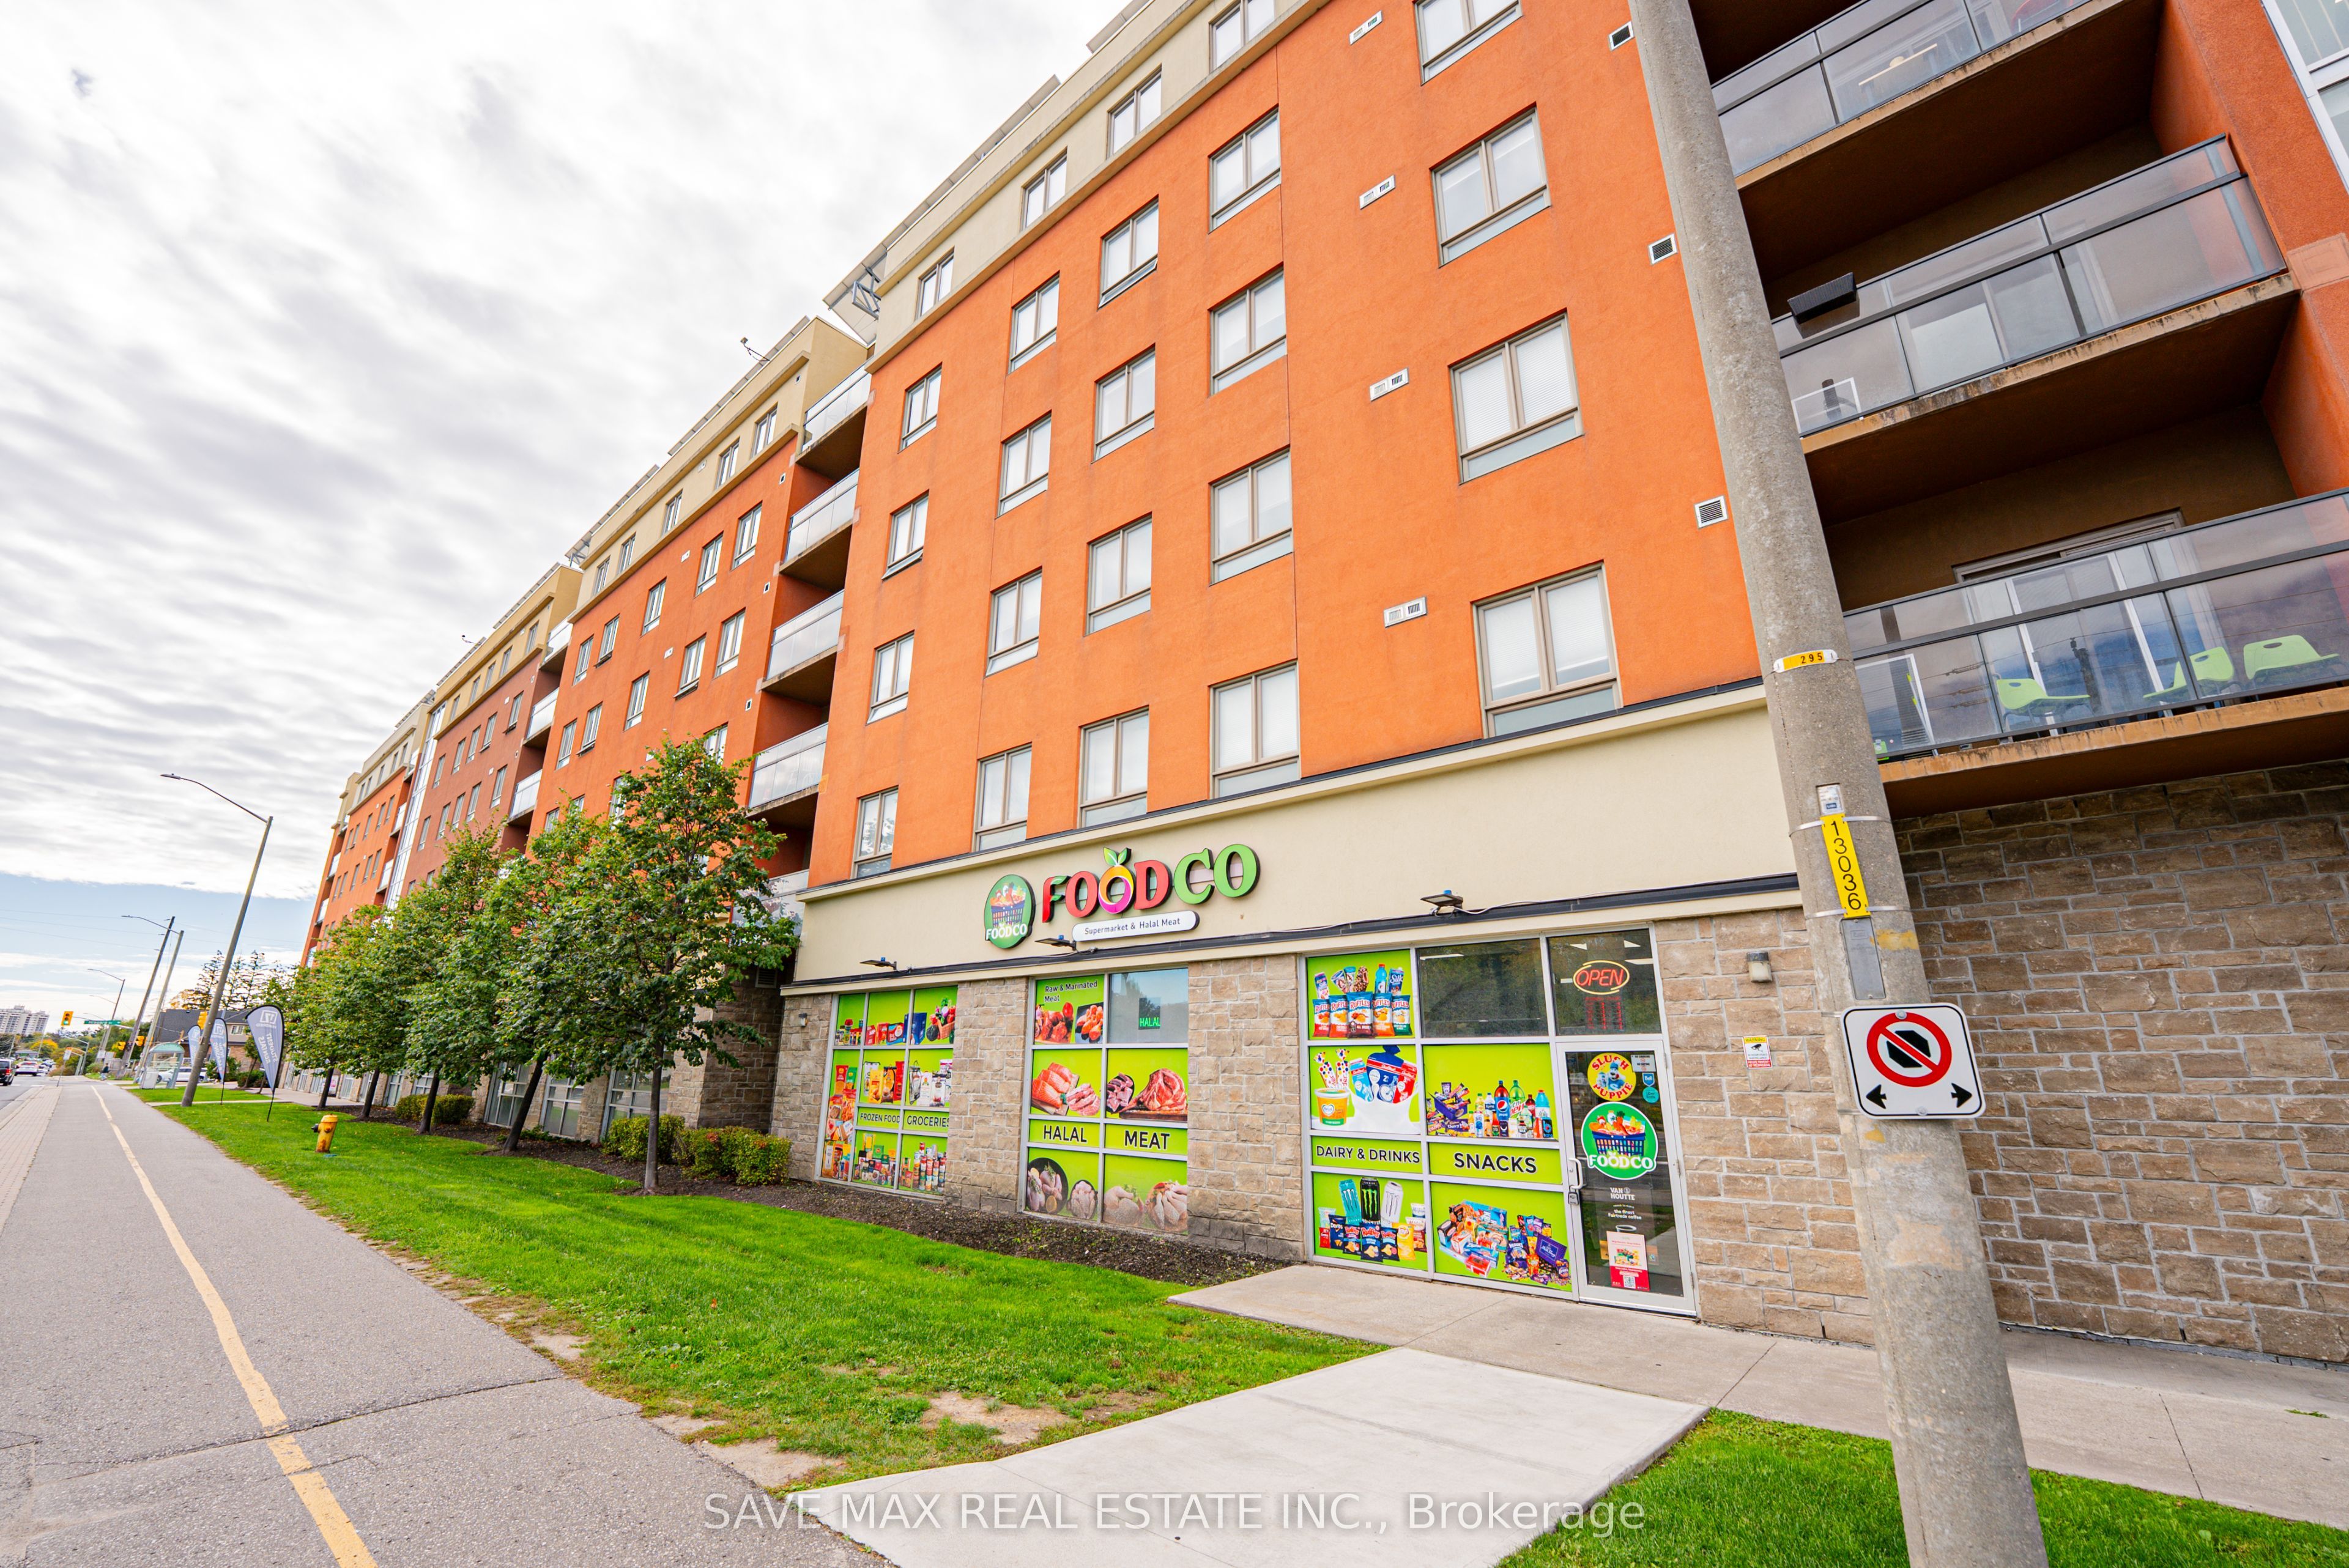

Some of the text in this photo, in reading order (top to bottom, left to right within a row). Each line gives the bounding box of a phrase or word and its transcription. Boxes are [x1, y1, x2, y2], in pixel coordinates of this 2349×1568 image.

[1800, 653, 1823, 664] 295
[1830, 820, 1861, 911] 13036
[1042, 844, 1261, 923] FOODCO
[985, 922, 1027, 941] FOODCO
[1085, 923, 1128, 935] Supermarket
[1139, 919, 1159, 929] Halal
[1162, 918, 1181, 926] Meat
[1065, 980, 1098, 991] Marinated
[1576, 969, 1624, 986] OPEN
[1044, 994, 1060, 1003] Meat
[1350, 999, 1370, 1010] RUFFLES
[1140, 1017, 1160, 1027] HALAL
[860, 1113, 900, 1123] FROZEN FOOD
[1044, 1125, 1170, 1150] HALAL MEAT
[1316, 1145, 1420, 1164] DAIRY & DRINKS
[1454, 1152, 1537, 1174] SNACKS
[1588, 1151, 1653, 1169] FOODCO
[1360, 1227, 1380, 1238] Ruffles
